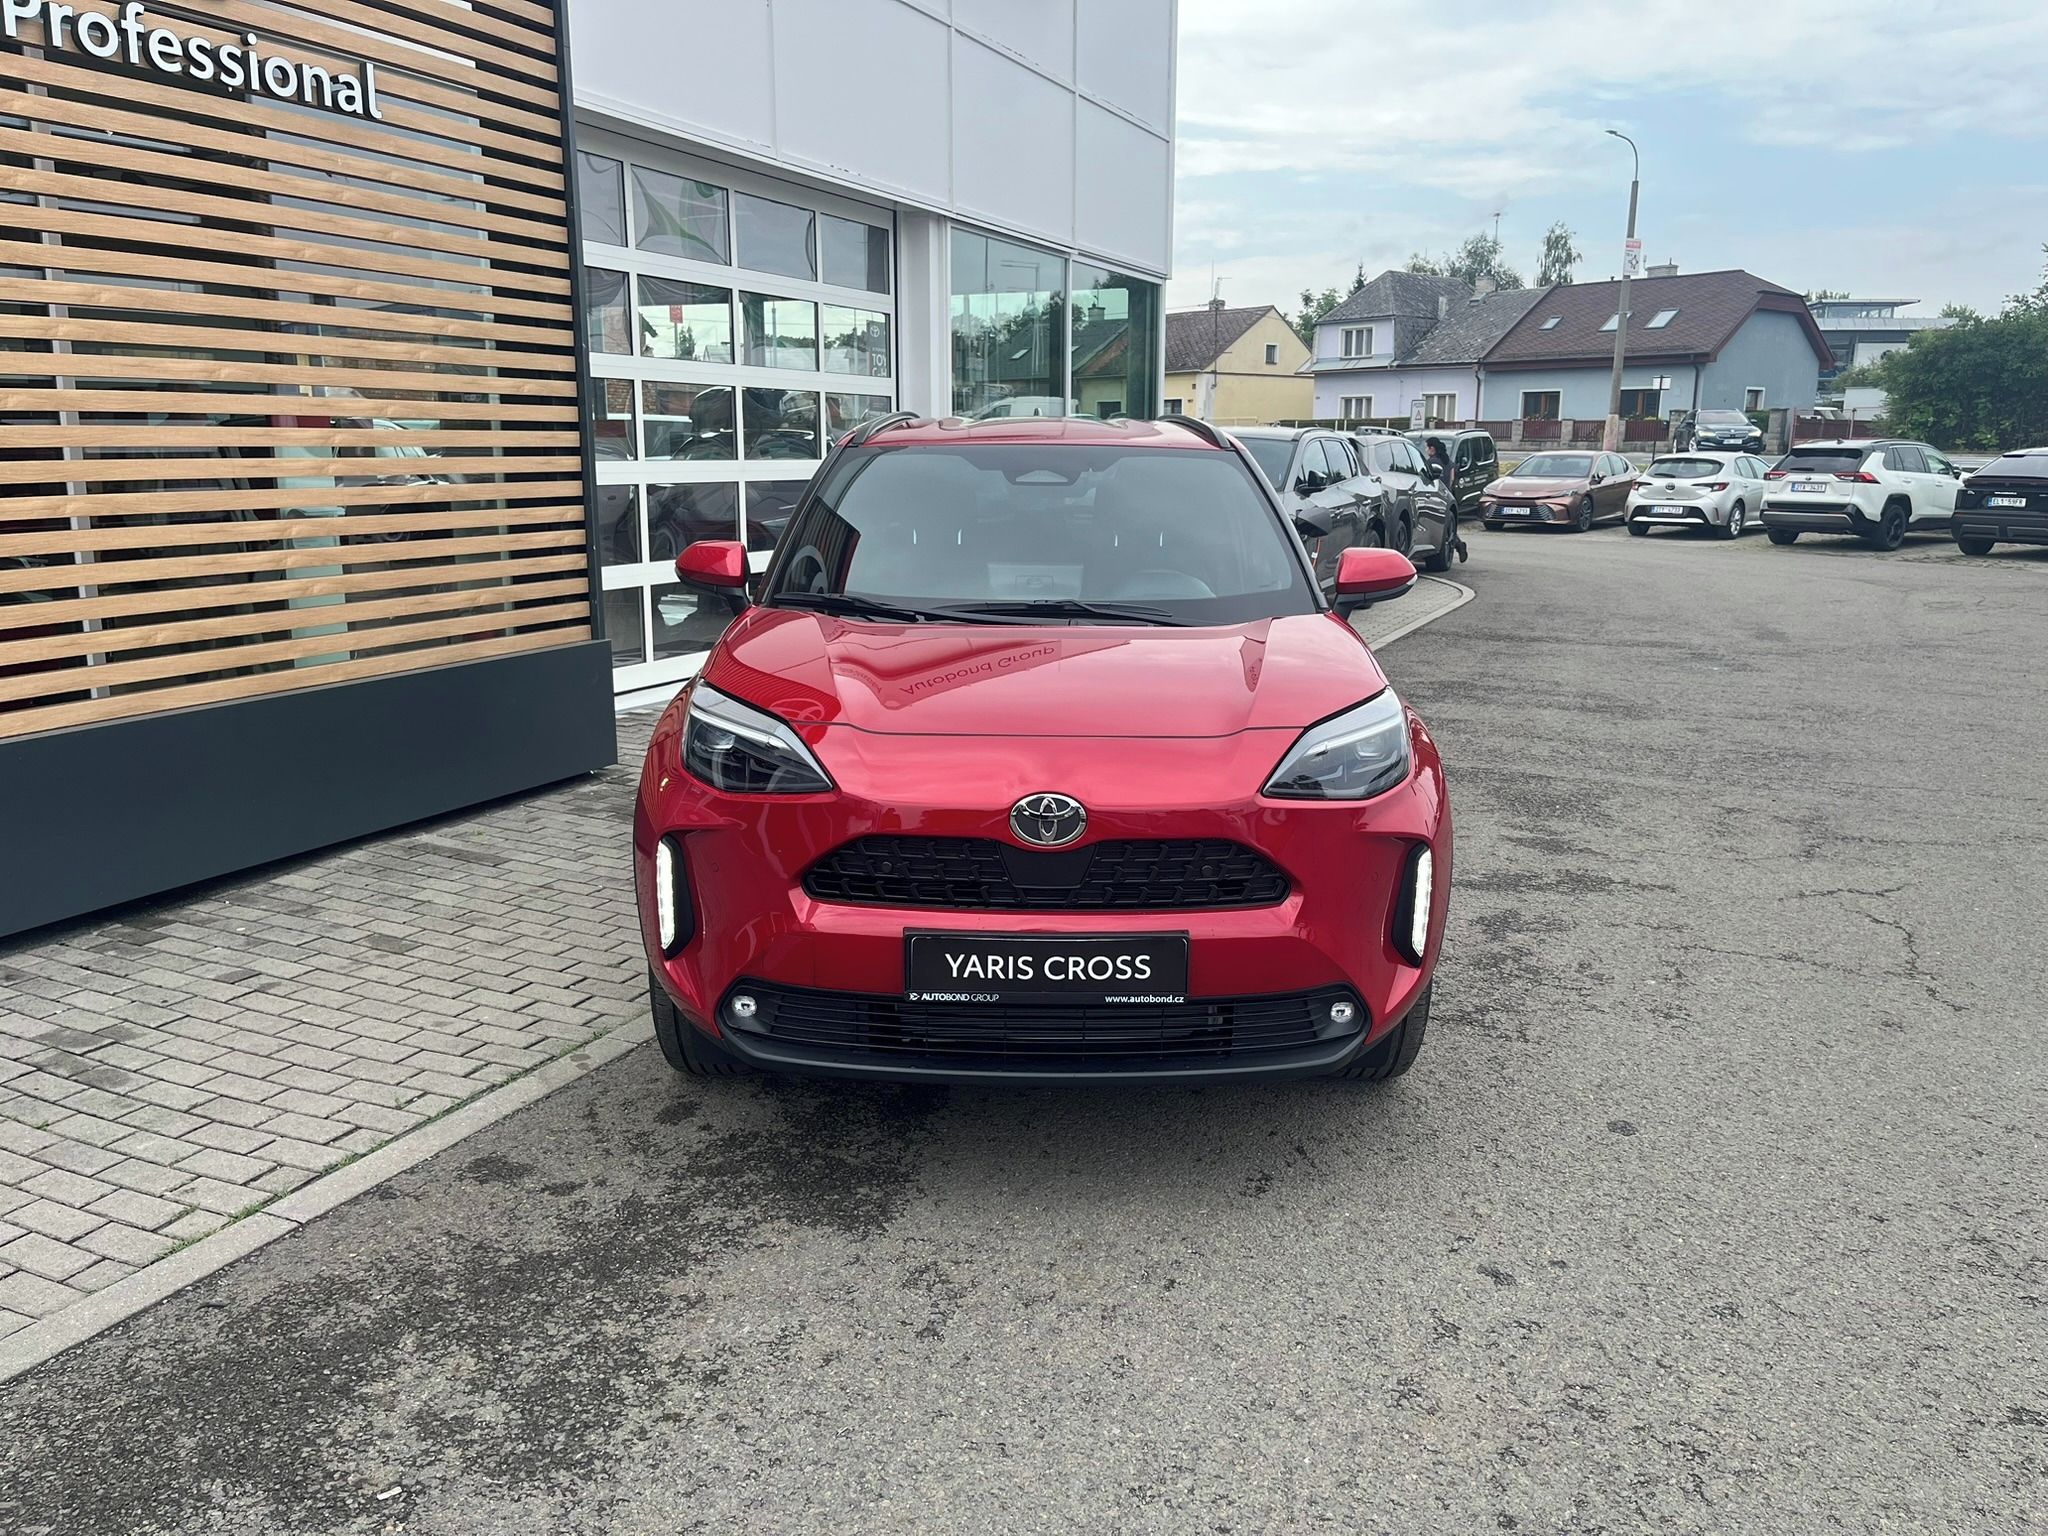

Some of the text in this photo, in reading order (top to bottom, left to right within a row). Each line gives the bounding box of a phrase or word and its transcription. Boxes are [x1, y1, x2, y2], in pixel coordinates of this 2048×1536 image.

[3, 0, 382, 119] Professional
[944, 953, 1152, 981] YARIS CROSS
[921, 992, 1000, 1002] AUTOBOND GROUP
[1104, 994, 1185, 1004] www.autobond.cz
